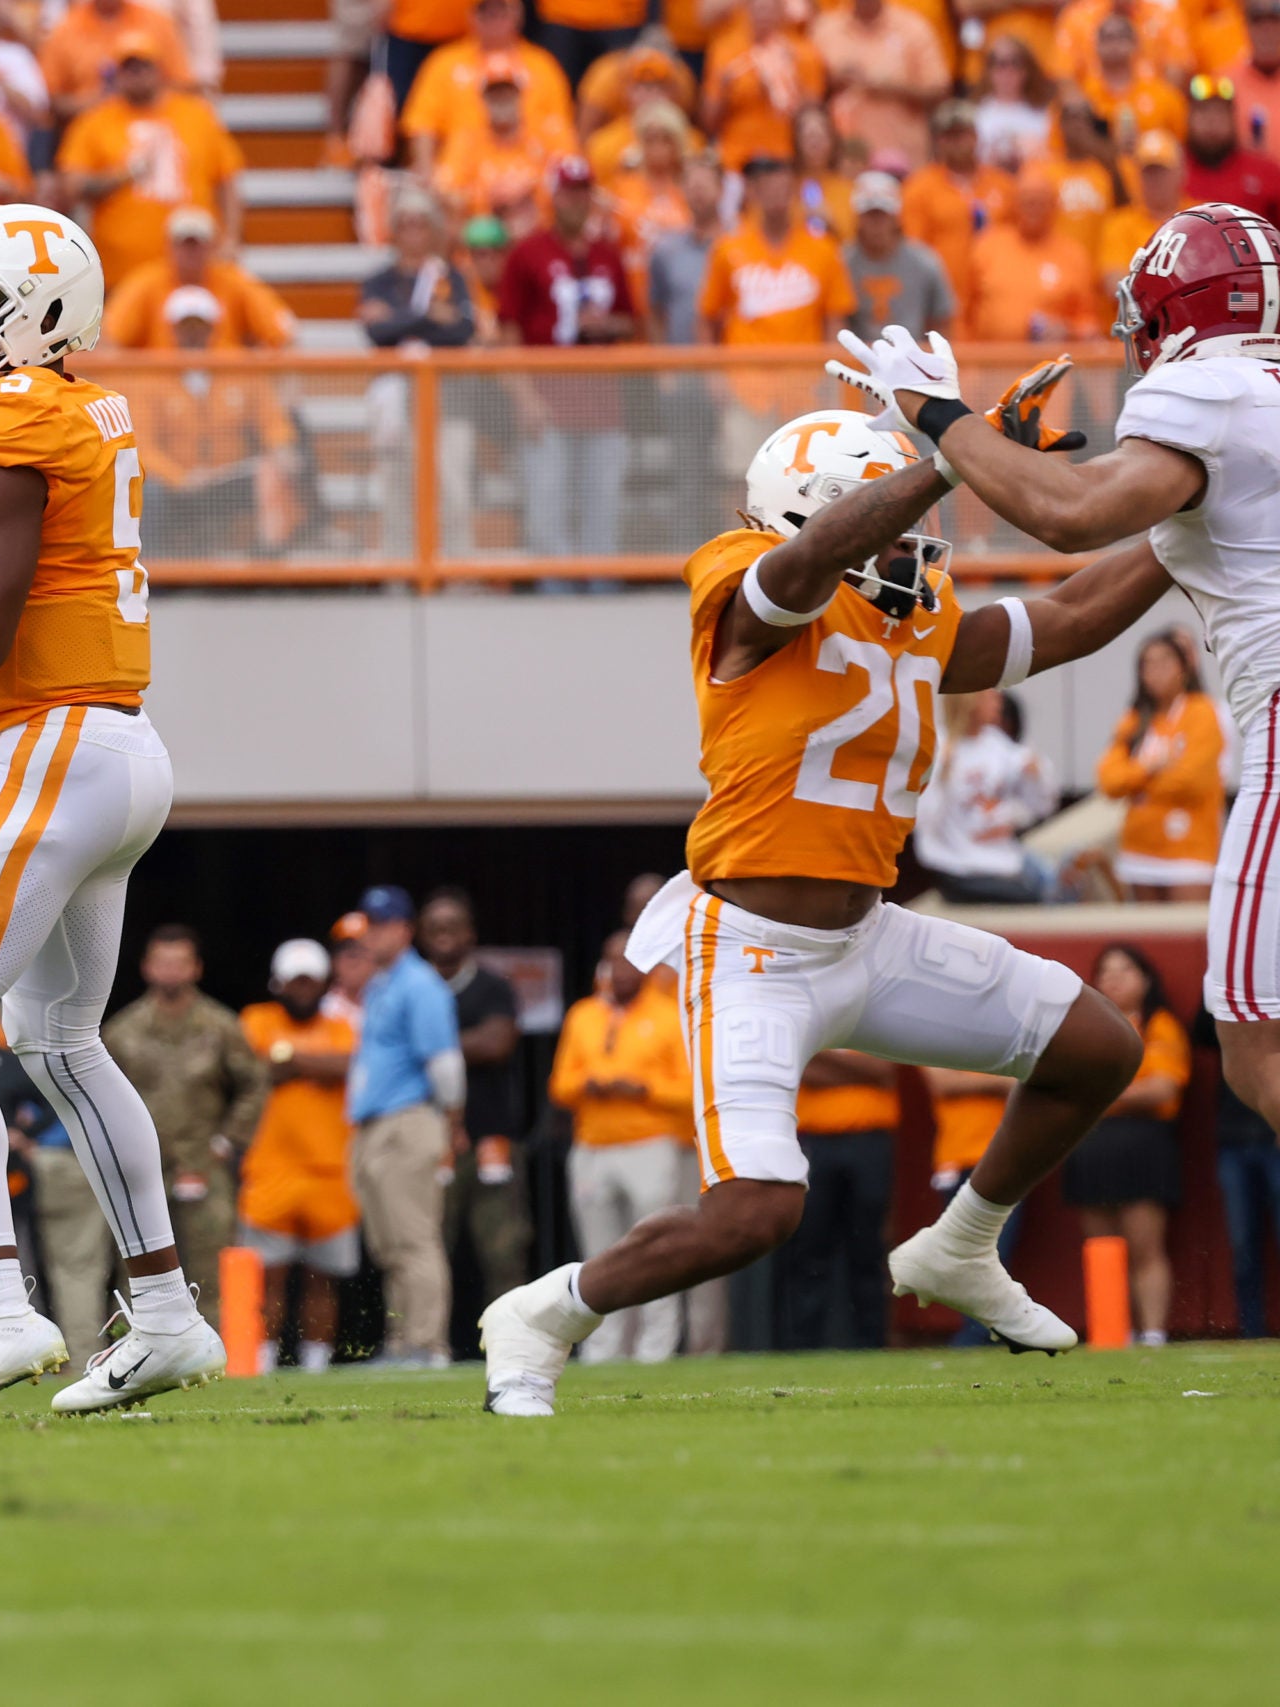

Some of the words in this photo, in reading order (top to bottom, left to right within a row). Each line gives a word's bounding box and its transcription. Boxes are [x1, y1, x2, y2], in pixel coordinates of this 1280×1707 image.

[3, 220, 64, 275] T
[780, 421, 842, 477] T
[882, 616, 900, 639] T
[793, 631, 941, 818] 20
[743, 946, 774, 973] T
